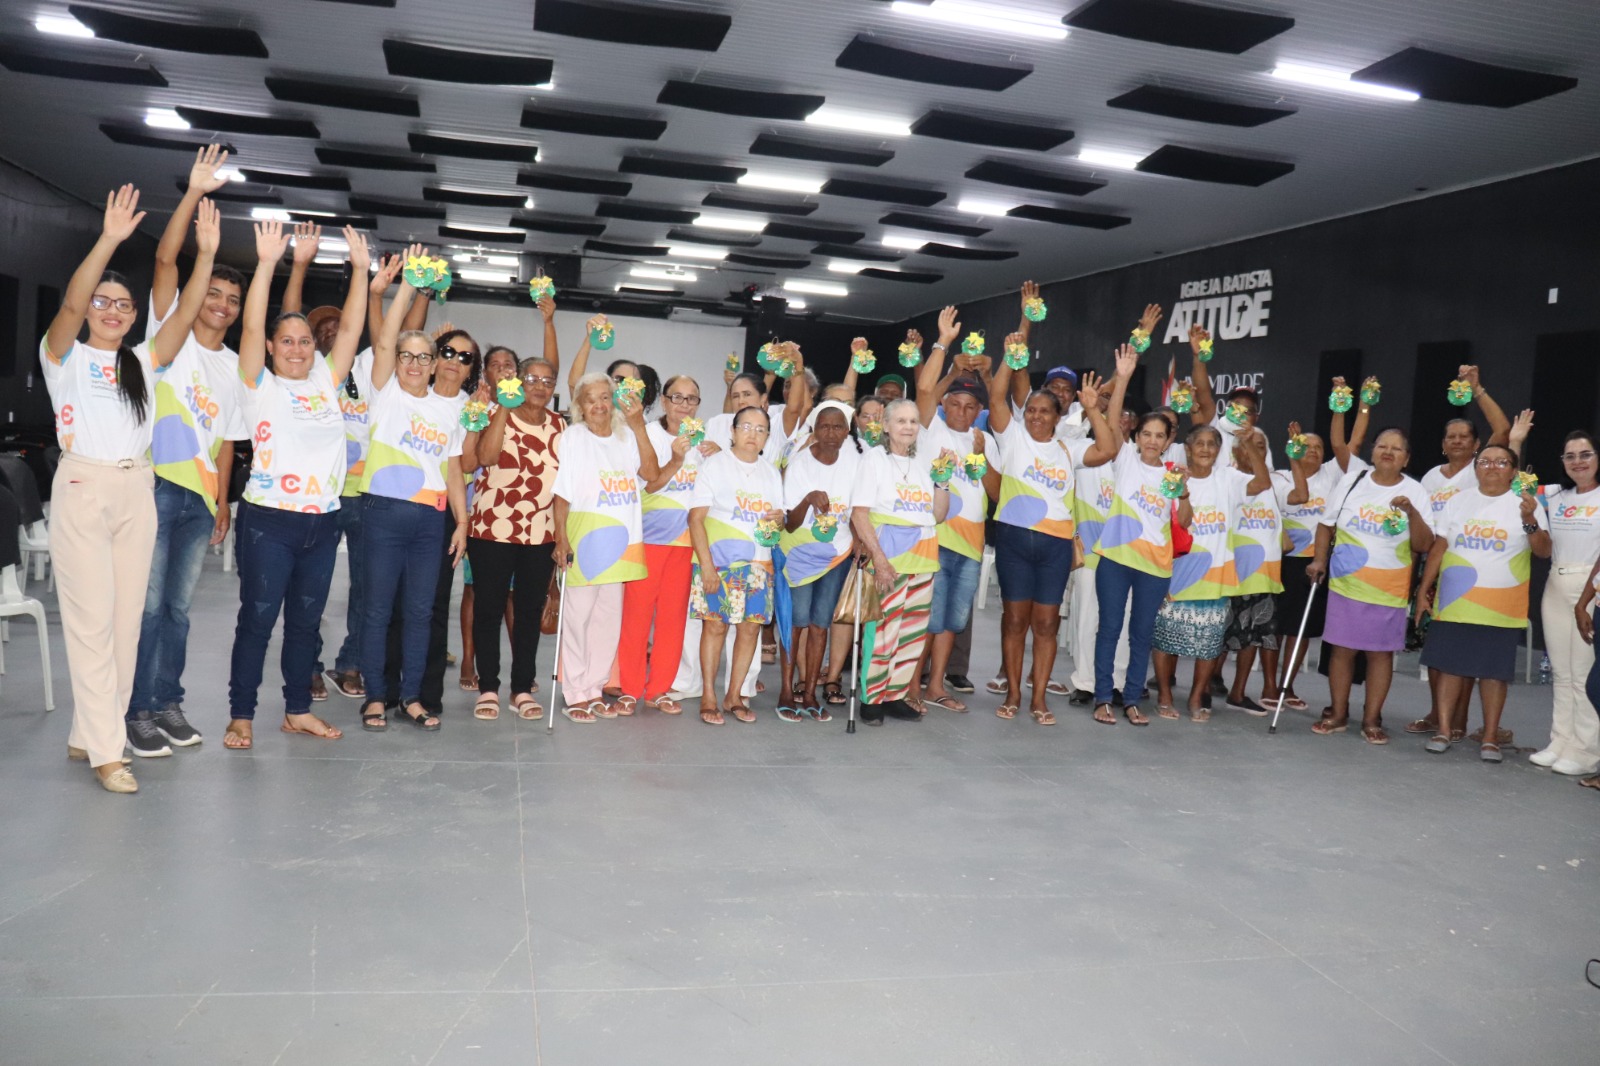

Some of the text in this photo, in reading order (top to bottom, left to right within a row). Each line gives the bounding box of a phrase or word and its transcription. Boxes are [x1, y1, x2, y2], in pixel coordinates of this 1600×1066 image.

[1180, 269, 1273, 299] IGREJA BATISTA
[1163, 290, 1272, 344] ATITUDE
[1184, 373, 1265, 395] MIDADE
[410, 420, 448, 446] Vida
[674, 469, 698, 483] Vid
[664, 480, 695, 493] Ativ
[896, 488, 932, 502] Vida
[736, 496, 773, 513] Vida
[730, 505, 765, 523] Ativ
[1242, 508, 1276, 520] Vida
[1360, 506, 1386, 523] Vid
[1237, 516, 1276, 531] Ativa
[1346, 515, 1390, 537] Ativ
[1464, 525, 1508, 541] Vida
[1455, 533, 1506, 552] Ativa
